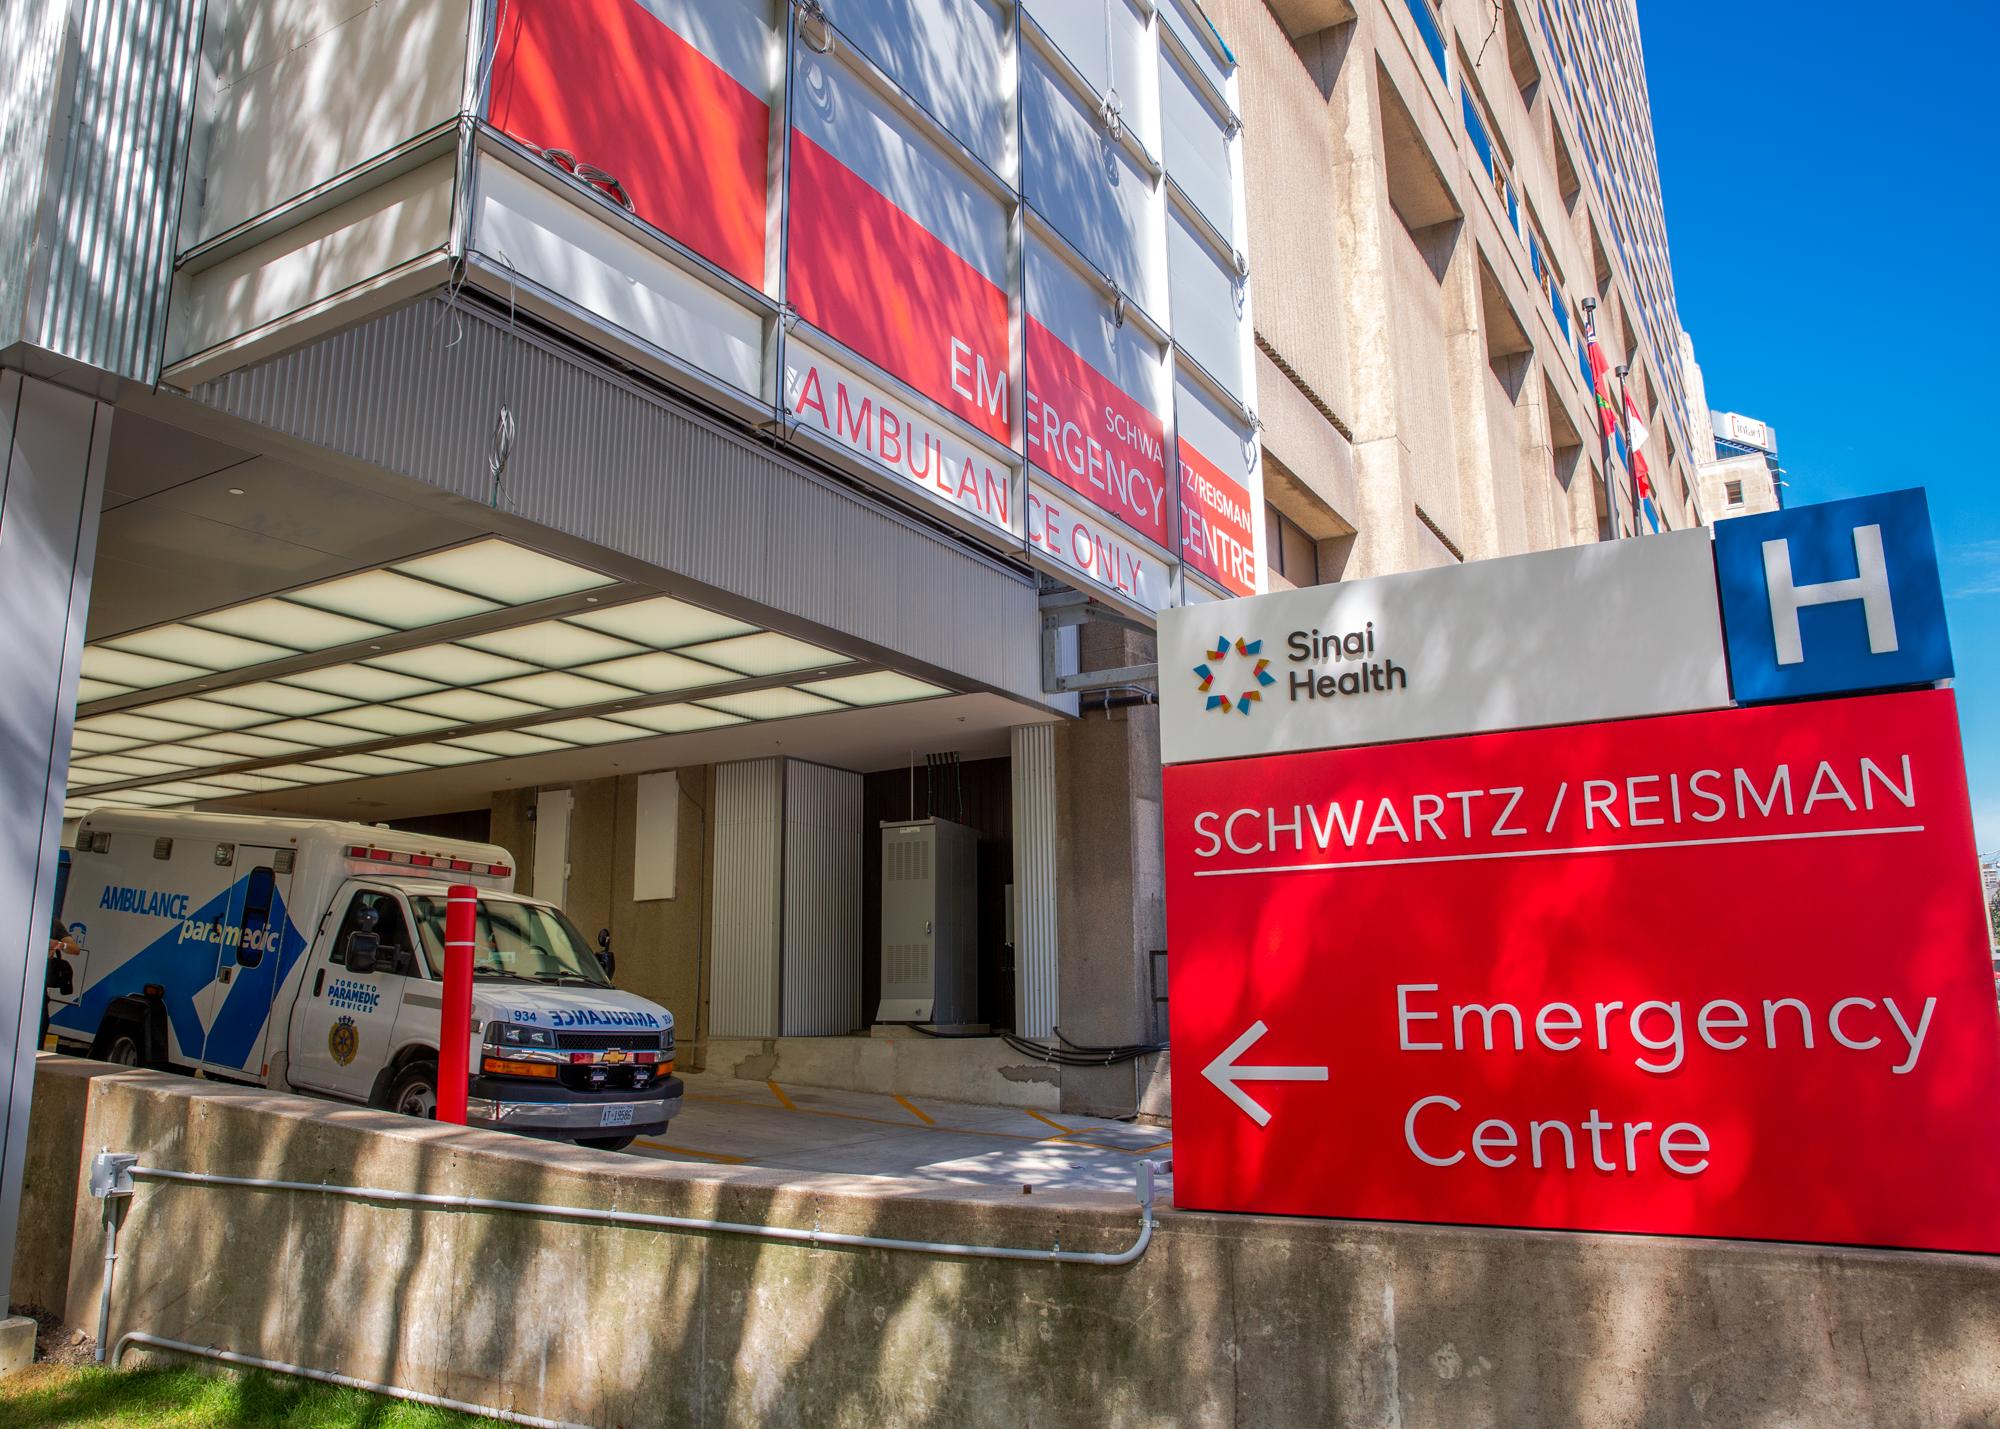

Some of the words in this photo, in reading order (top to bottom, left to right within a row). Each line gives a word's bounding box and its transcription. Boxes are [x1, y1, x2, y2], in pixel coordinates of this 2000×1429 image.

[1071, 523, 1142, 597] ONLY
[1762, 523, 1899, 666] H
[1287, 621, 1375, 662] Sinai
[1288, 659, 1407, 702] Health
[1193, 786, 1528, 858] SCHWARTZ
[1582, 754, 1917, 831] REISMAN
[100, 885, 190, 921] AMBULANCE
[177, 918, 281, 953] paramedic
[327, 985, 380, 1007] PARAMEDIC
[329, 998, 373, 1014] SERVICES
[334, 978, 377, 993] TORONTO
[514, 1010, 537, 1023] 934
[1397, 983, 1937, 1074] Emergency
[1404, 1095, 1710, 1174] Centre
